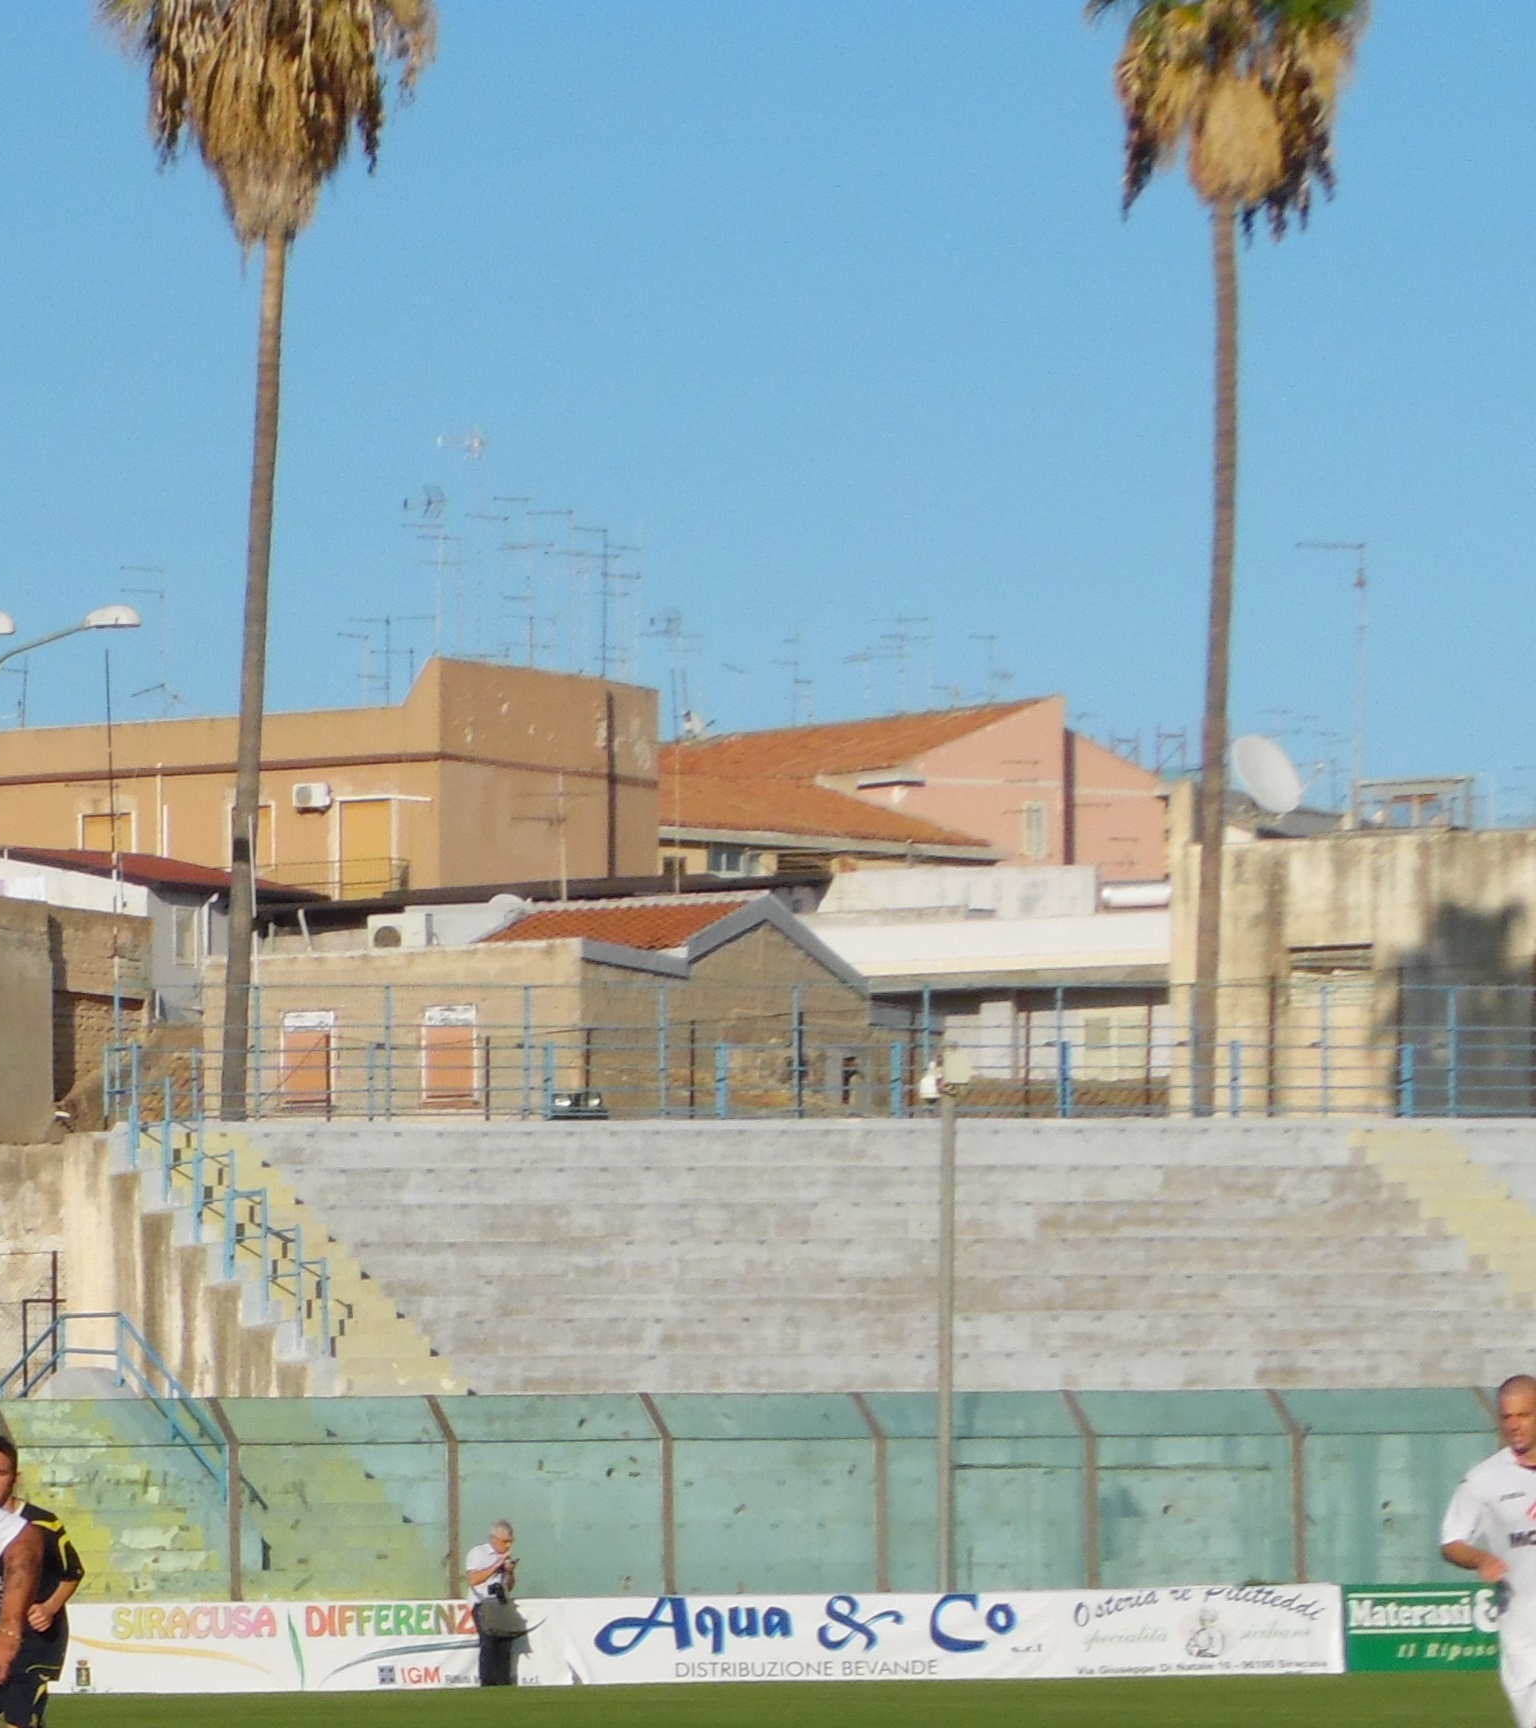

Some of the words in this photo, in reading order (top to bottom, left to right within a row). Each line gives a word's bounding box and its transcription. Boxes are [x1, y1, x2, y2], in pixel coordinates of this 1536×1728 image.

[112, 1606, 277, 1640] SIRACUSA
[306, 1604, 478, 1637] DIFFERENZ
[594, 1597, 794, 1657] Aqua
[817, 1595, 904, 1651] &
[930, 1594, 1017, 1653] Co
[1349, 1598, 1472, 1628] Materassi
[401, 1666, 441, 1685] IGM
[675, 1660, 835, 1678] DISTRIBUZIONE
[842, 1659, 938, 1676] BEVANDE
